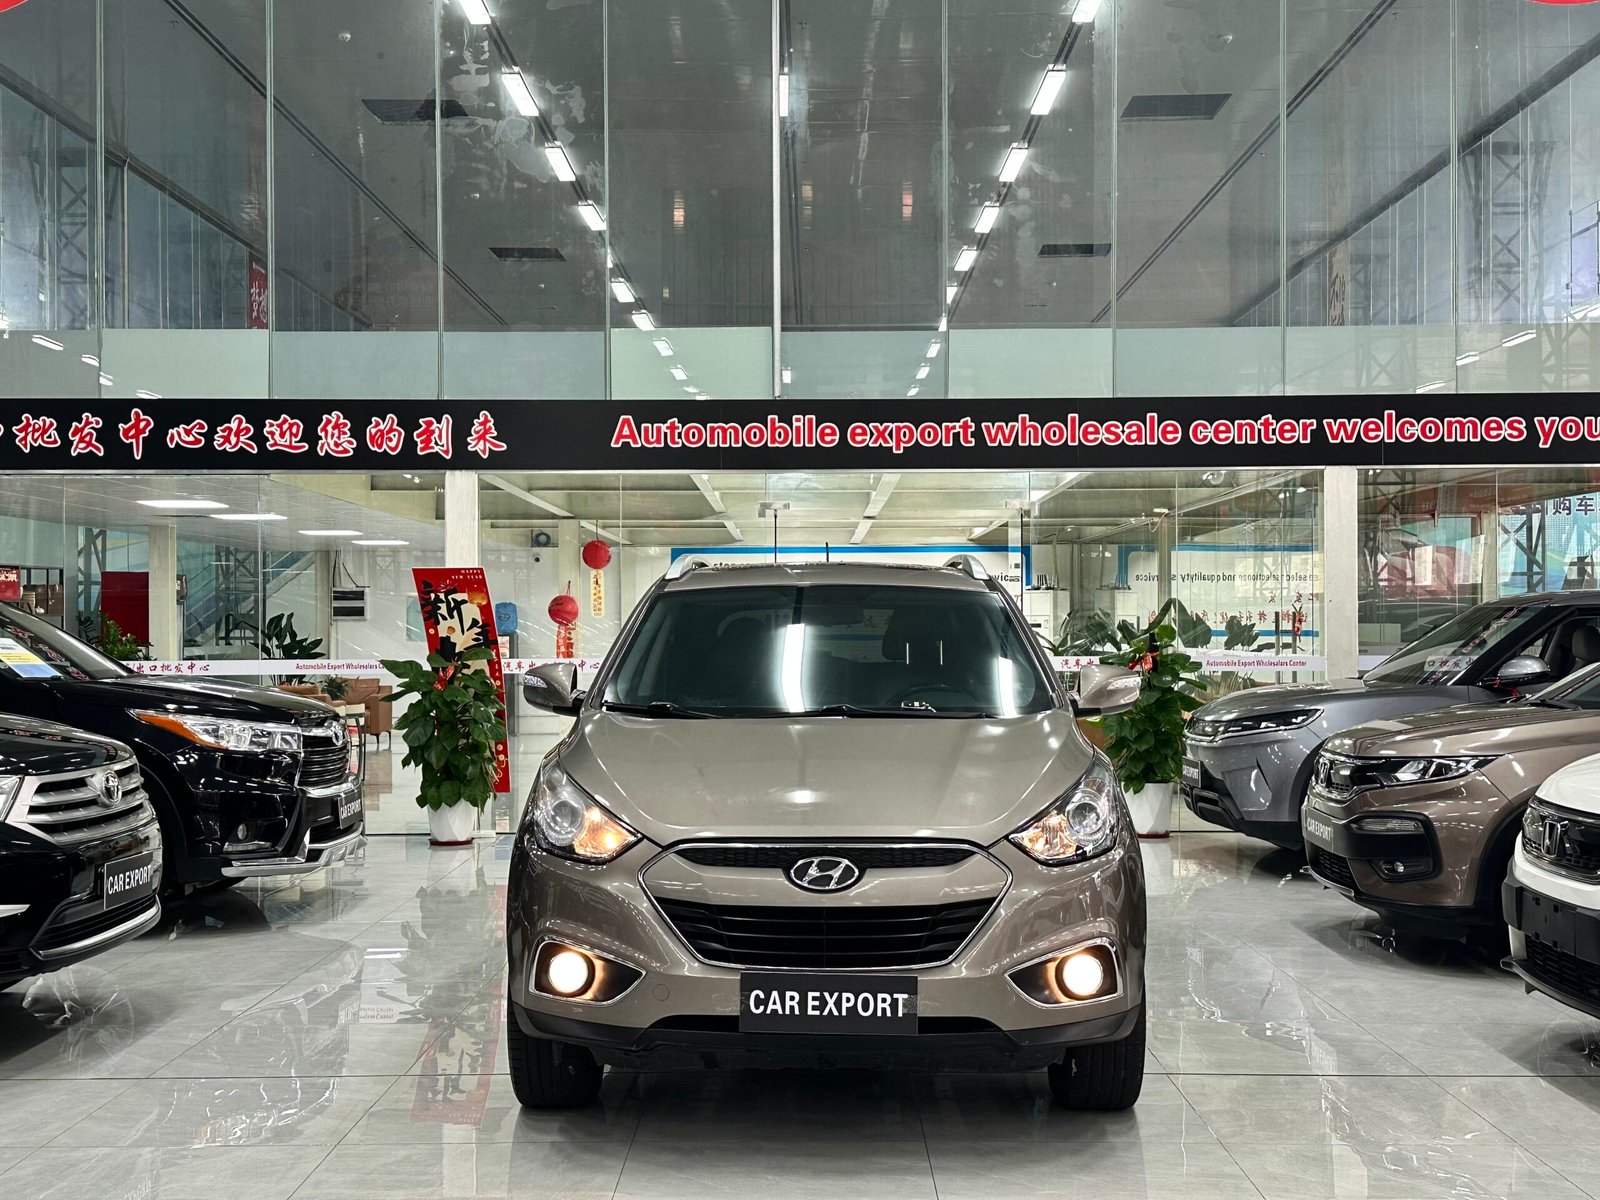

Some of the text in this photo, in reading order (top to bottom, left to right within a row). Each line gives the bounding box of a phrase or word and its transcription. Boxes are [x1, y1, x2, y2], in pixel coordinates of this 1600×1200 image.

[0, 408, 507, 460] 批发中心欢迎您的到来
[610, 409, 1600, 453] Automobile export wholesale center welcomes you
[1545, 496, 1600, 516] 购车
[126, 661, 210, 674] 出口批发中心
[327, 663, 345, 671] Export
[503, 660, 600, 672] 汽车出中心
[1237, 660, 1256, 668] Export
[108, 864, 152, 895] CAR EXPORT
[749, 989, 909, 1018] CAR EXPORT
